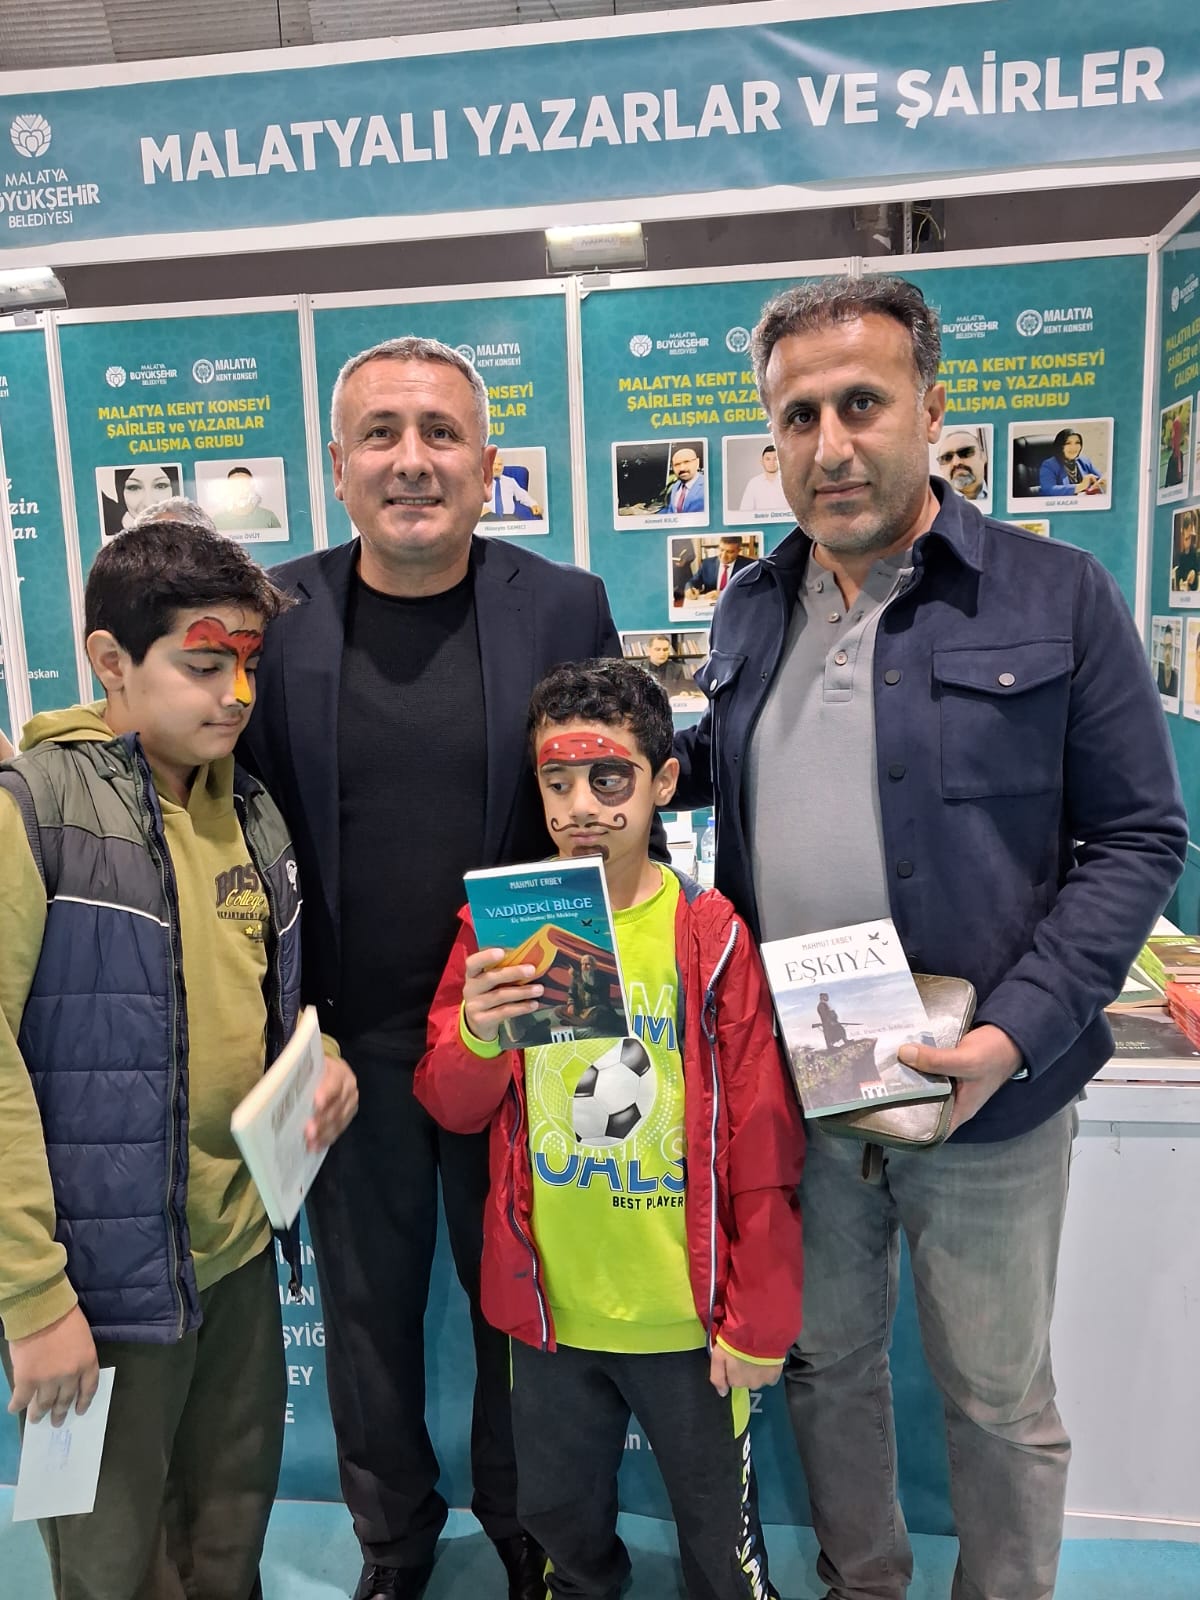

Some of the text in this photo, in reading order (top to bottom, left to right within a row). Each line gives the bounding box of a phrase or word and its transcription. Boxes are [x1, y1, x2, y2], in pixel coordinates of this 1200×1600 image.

[140, 46, 1165, 185] MALATYALI YAZARLAR VE ŞAİRLER
[5, 168, 68, 188] MALATYA
[0, 183, 101, 212] YÜKŞEHİR
[8, 210, 73, 229] BELEDİYESİ
[1044, 306, 1094, 322] MALATYA
[476, 342, 521, 357] MALATYA
[215, 358, 257, 371] MALATYA
[477, 357, 493, 367] KENT
[982, 356, 1027, 372] KENT
[1031, 348, 1105, 370] KONSEYİ
[619, 374, 692, 392] MALATYA
[695, 371, 737, 387] KENT
[983, 379, 1001, 391] ve
[1006, 371, 1096, 390] YAZARLAR
[98, 394, 271, 421] MALATYA KENT KONSEYİ
[627, 392, 692, 412] ŞAİRLER
[696, 394, 714, 406] ve
[945, 392, 1071, 414] ALIŞMA GRUBU
[107, 415, 265, 439] ŞAİRLER ve YAZARLAR
[650, 407, 767, 429] ÇALIŞMA GRUB
[128, 434, 244, 455] ÇALIŞMA GRUBU
[27, 668, 59, 680] aşkanı
[509, 879, 538, 890] MAHMUT
[225, 889, 265, 913] College
[485, 897, 593, 920] VADİDEKİ BİLGE
[802, 939, 829, 951] MAHMUT
[785, 947, 886, 982] EŞKIYA
[612, 1195, 684, 1211] BEST PLAYER
